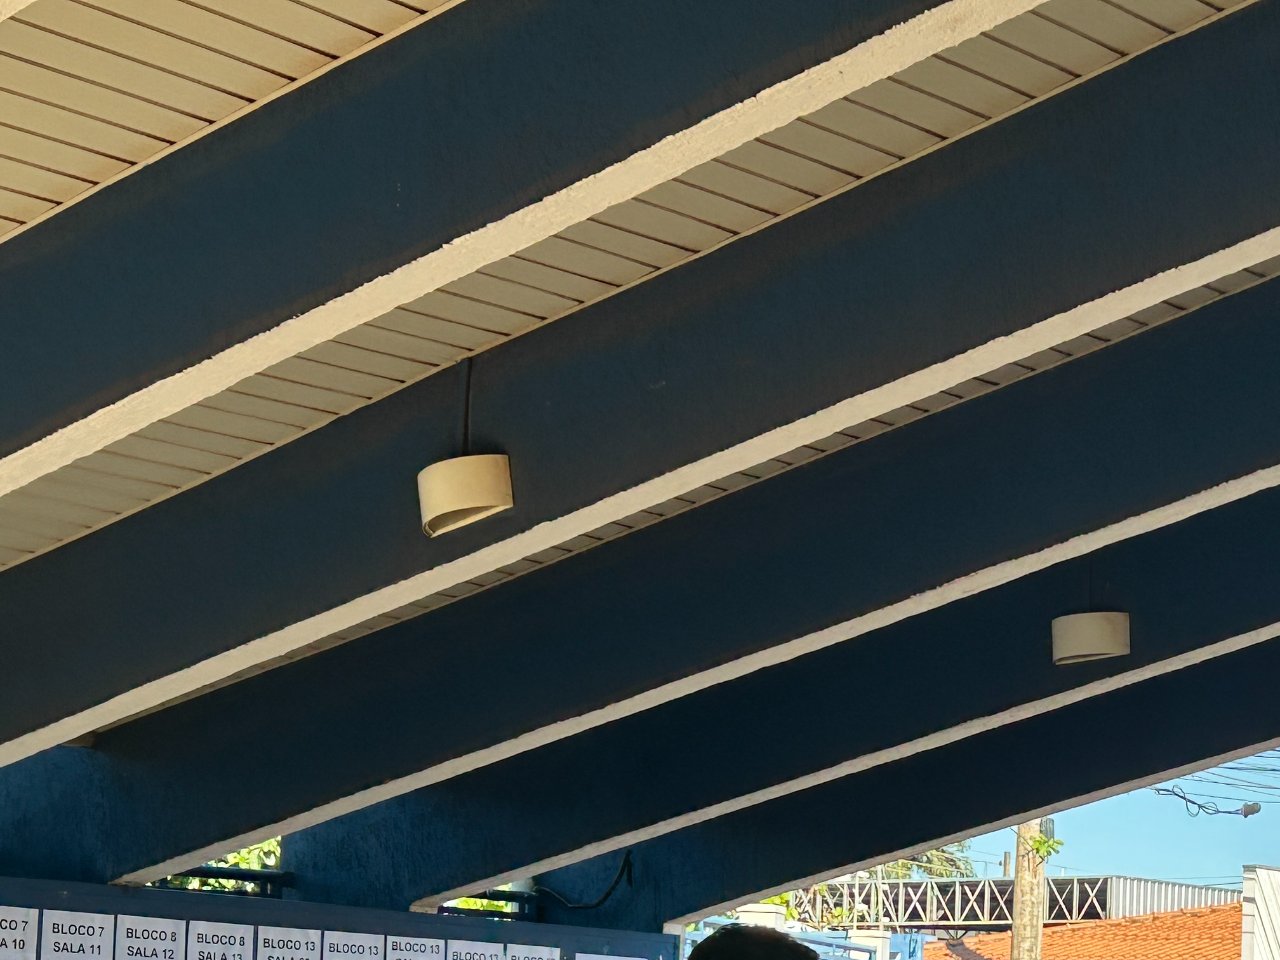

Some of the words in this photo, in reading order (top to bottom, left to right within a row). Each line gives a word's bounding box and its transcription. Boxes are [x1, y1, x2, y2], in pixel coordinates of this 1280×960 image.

[21, 920, 28, 931] 7
[52, 922, 95, 936] BLOCO
[98, 926, 104, 937] 7
[126, 927, 167, 941] BLOCO
[170, 931, 177, 942] 8
[197, 933, 236, 946] BLOCO
[239, 936, 245, 947] 8
[12, 939, 25, 949] 10
[53, 941, 85, 954] SALA
[90, 944, 101, 955] 11
[263, 938, 301, 950] BLOCO
[305, 941, 316, 951] 13
[328, 942, 365, 954] BLOCO
[368, 945, 379, 956] 13
[392, 941, 427, 953] BLOCO
[430, 944, 440, 954] 13
[127, 946, 158, 958] SALA
[162, 949, 174, 959] 12
